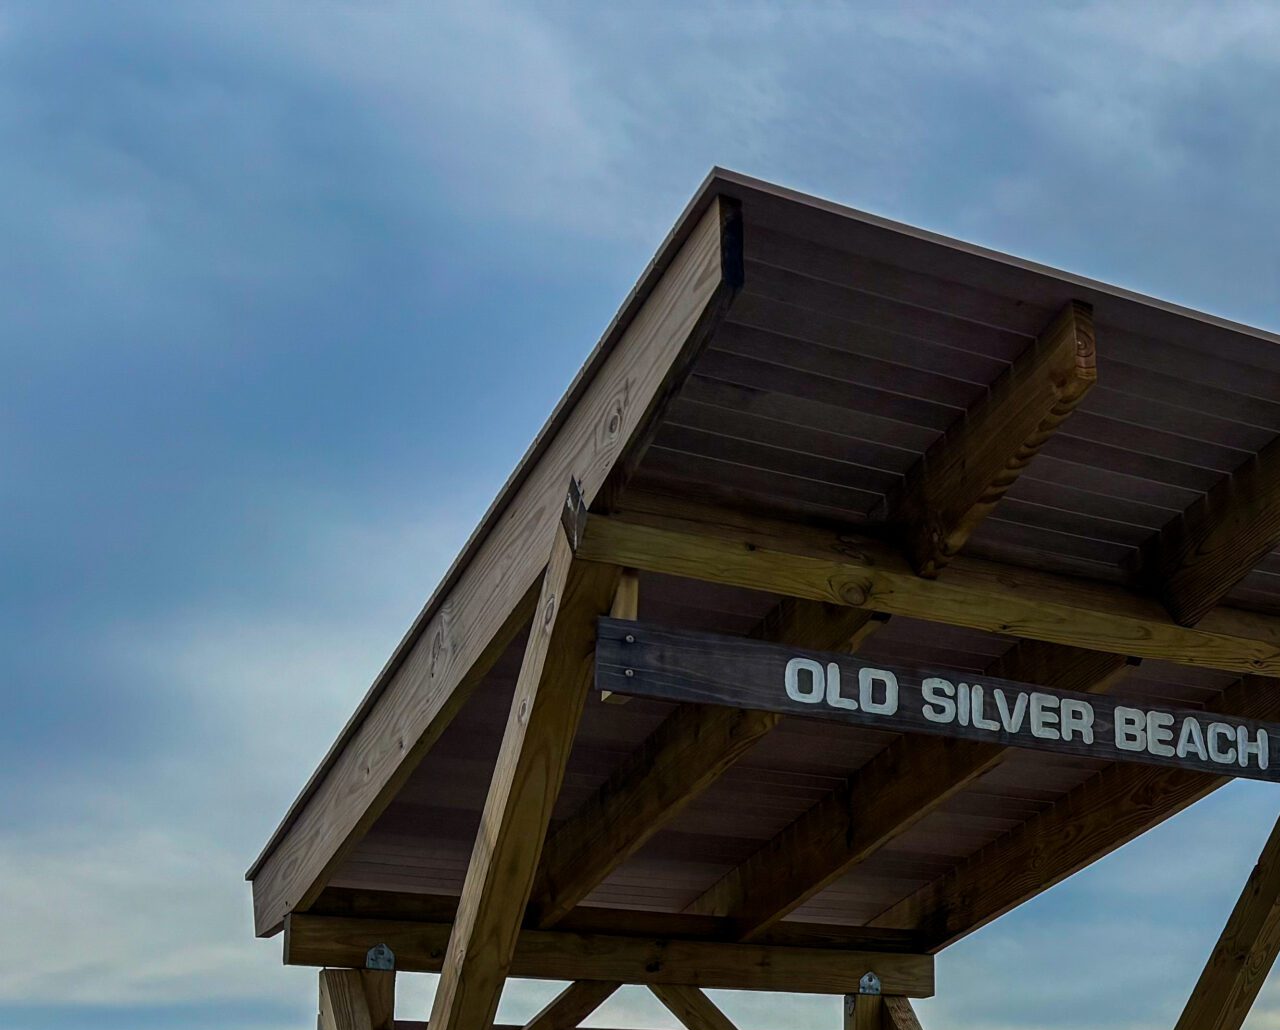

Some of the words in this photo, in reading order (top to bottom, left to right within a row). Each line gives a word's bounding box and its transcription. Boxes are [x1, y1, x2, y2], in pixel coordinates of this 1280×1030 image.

[784, 656, 899, 716] OLD
[921, 677, 1095, 745] SILVER
[1114, 706, 1269, 770] BEACH
